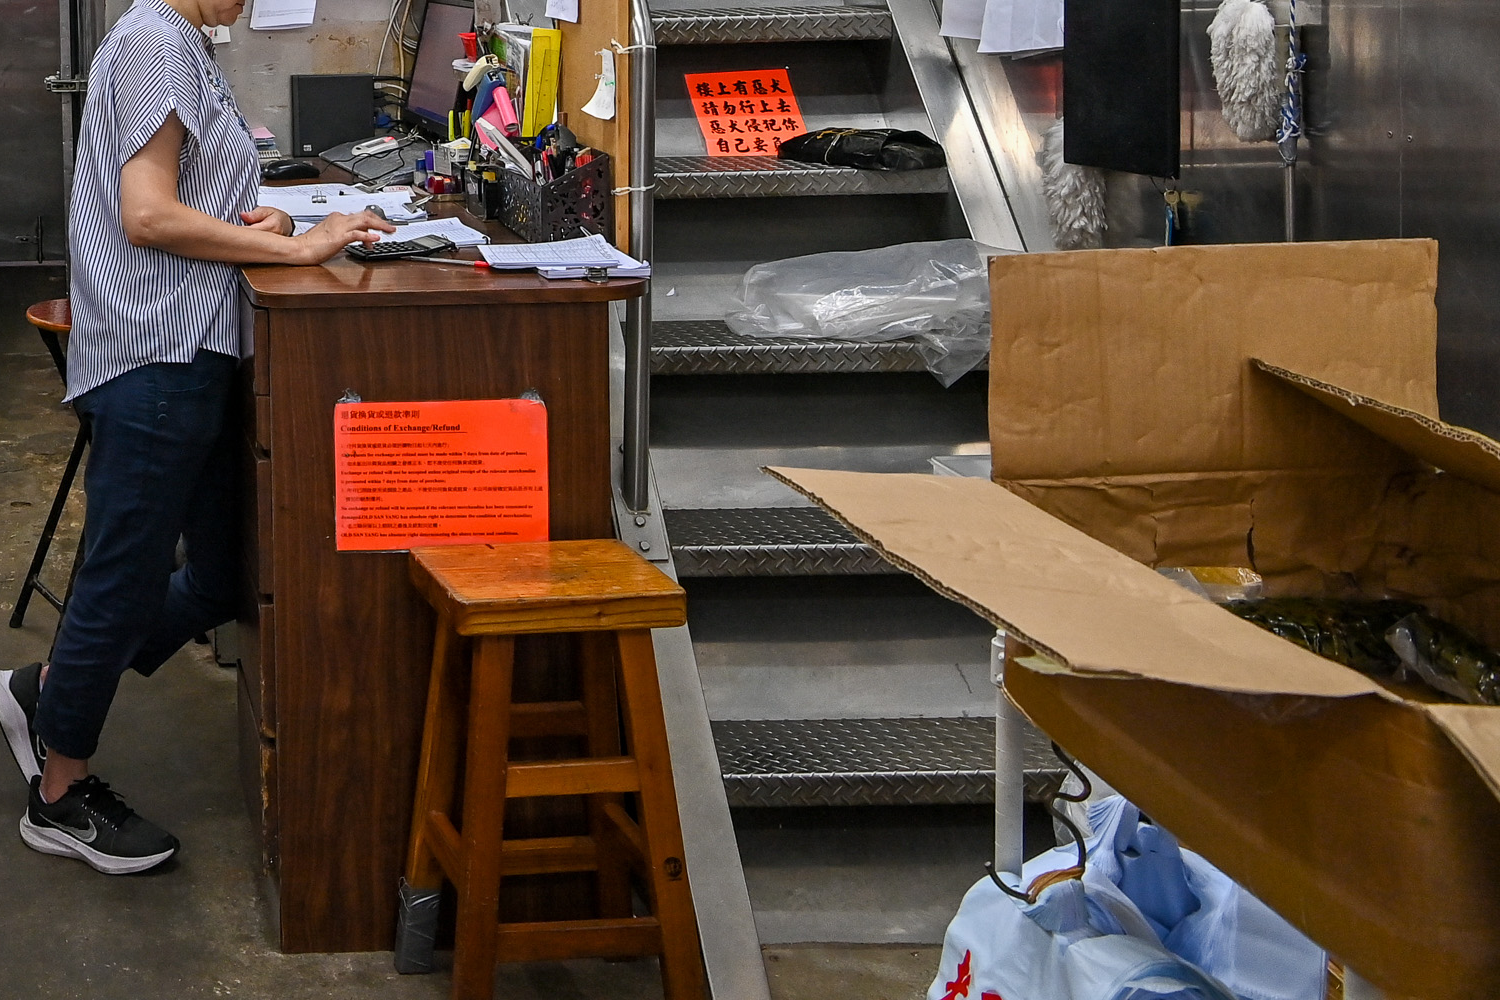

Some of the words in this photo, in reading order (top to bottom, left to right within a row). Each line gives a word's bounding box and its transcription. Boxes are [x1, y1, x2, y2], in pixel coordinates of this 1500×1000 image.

[695, 78, 787, 97] 樓上有惡犬
[701, 98, 791, 116] 請勿行上去
[709, 117, 799, 134] 惡犬侵犯你
[394, 424, 460, 433] Exchange/Refund
